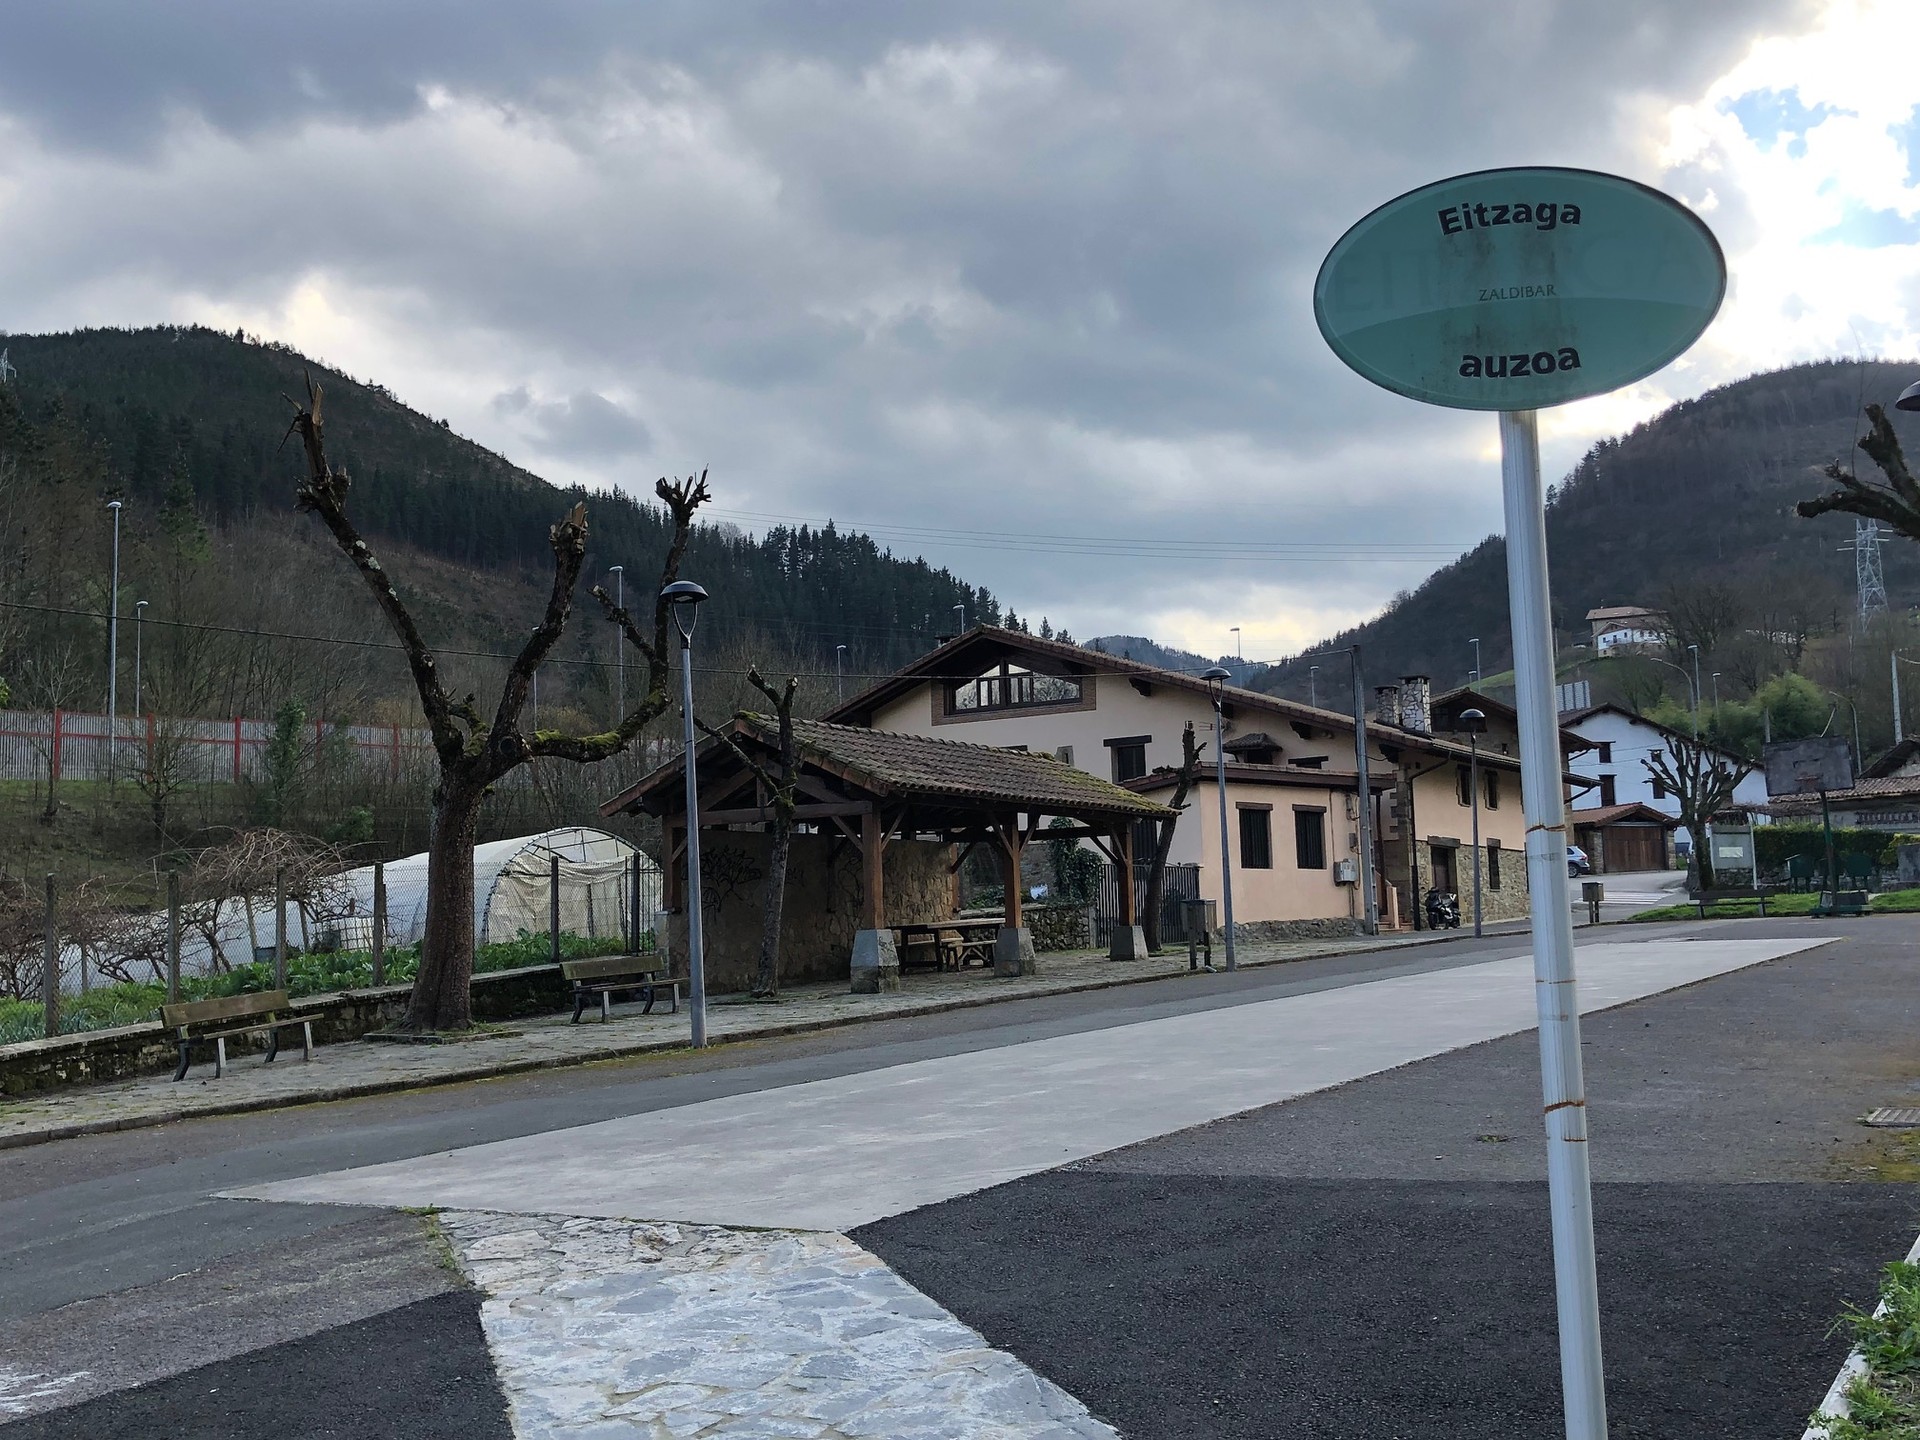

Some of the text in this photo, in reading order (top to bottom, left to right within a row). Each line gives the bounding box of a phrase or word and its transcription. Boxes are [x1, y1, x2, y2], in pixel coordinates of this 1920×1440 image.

[1438, 202, 1581, 235] Eitzaga
[1479, 284, 1556, 302] ZALDIBAR
[1458, 346, 1581, 378] auzoa
